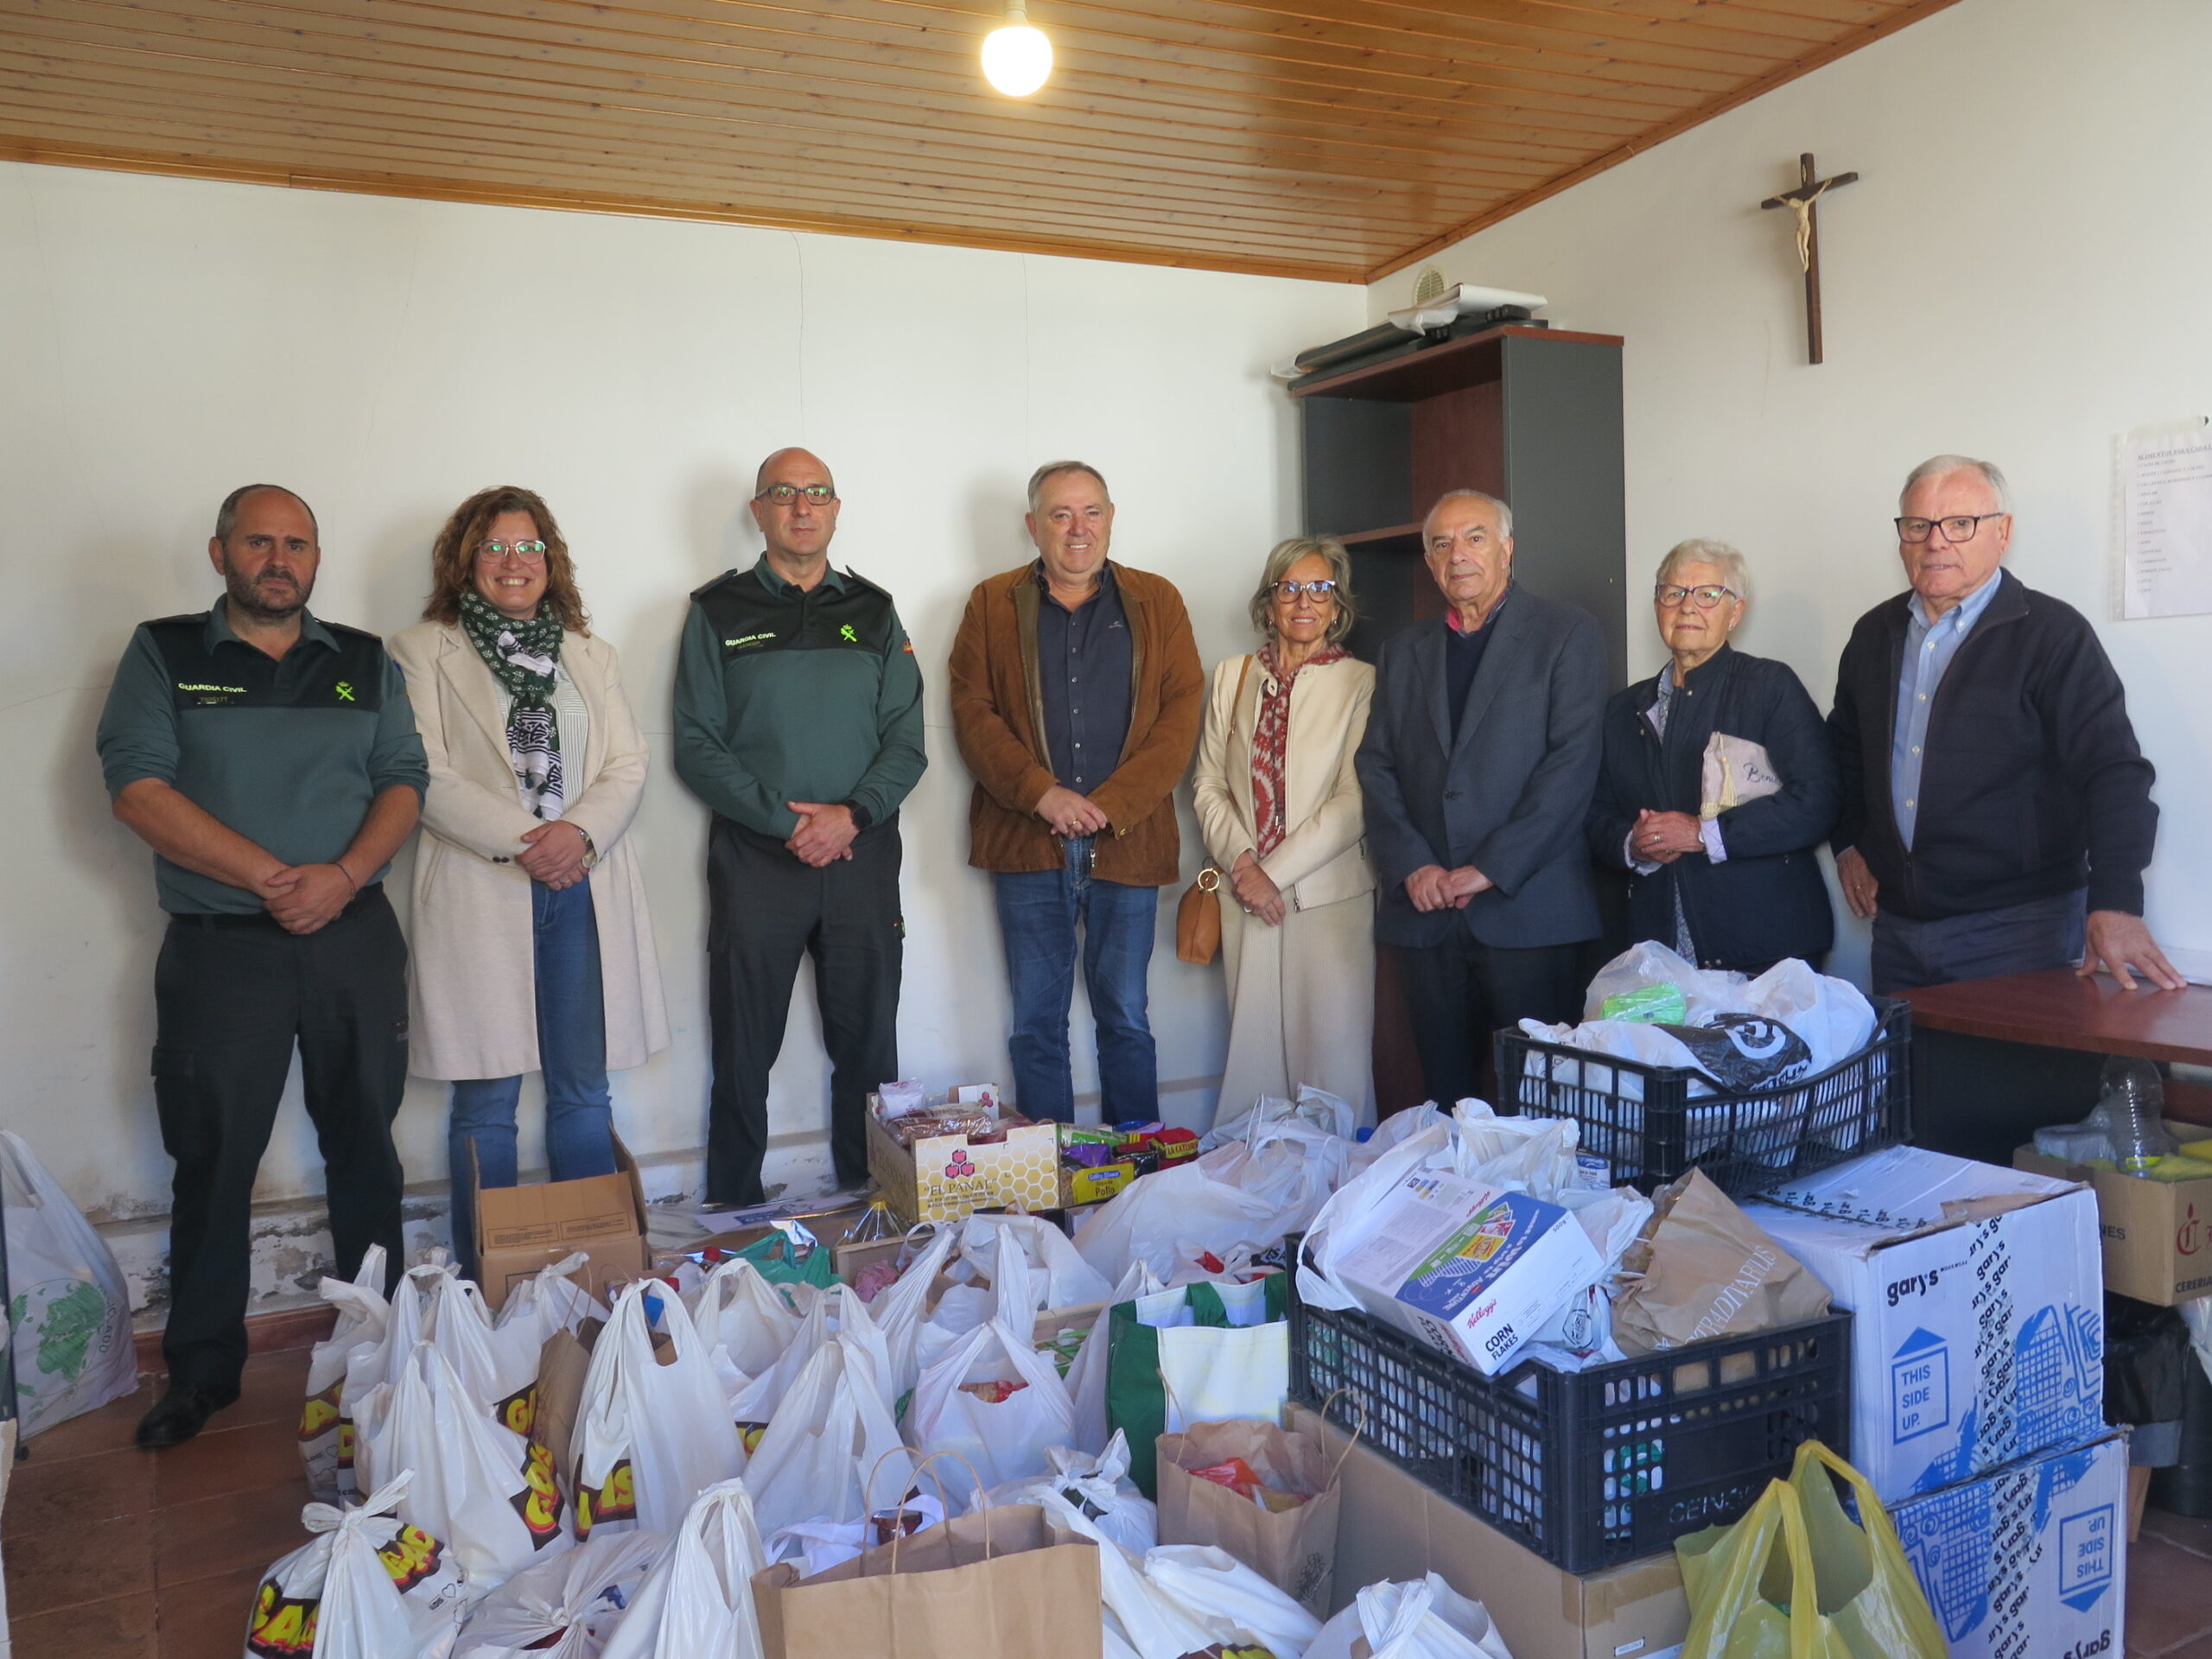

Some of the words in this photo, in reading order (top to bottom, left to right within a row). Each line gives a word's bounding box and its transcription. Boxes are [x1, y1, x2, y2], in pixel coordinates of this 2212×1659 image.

[725, 635, 756, 646] GUARDIA
[758, 632, 776, 640] CIVIL
[178, 683, 222, 691] GUARDIA
[1095, 1185, 1116, 1197] Pollo
[1887, 1270, 1938, 1306] gary's
[1466, 1299, 1497, 1329] Kellogg's
[1485, 1322, 1514, 1352] CORN
[1491, 1333, 1519, 1361] FLAKES
[1902, 1364, 1930, 1386] THIS
[1902, 1387, 1930, 1409] SIDE
[1903, 1413, 1920, 1430] UP.
[2078, 1536, 2105, 1557] SIDE
[2077, 1557, 2104, 1579] THIS
